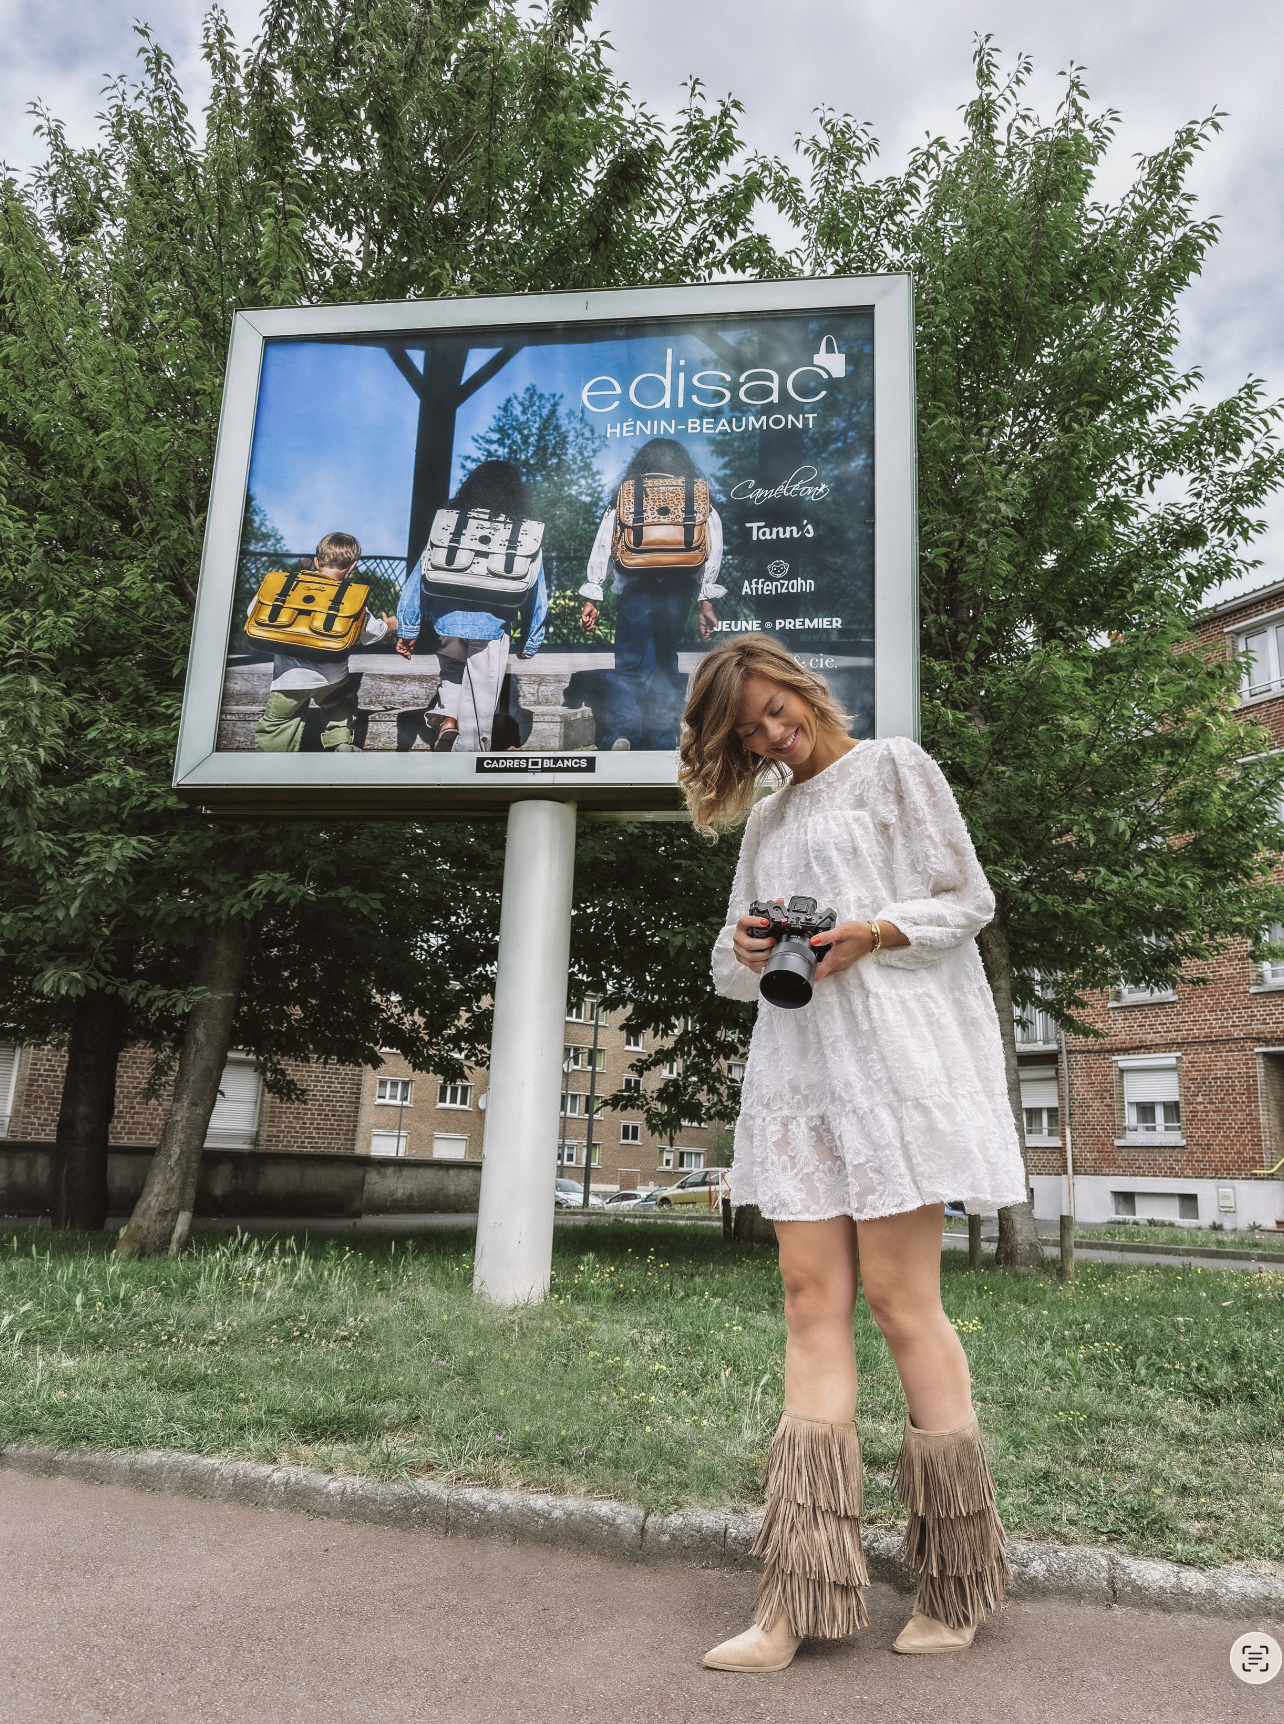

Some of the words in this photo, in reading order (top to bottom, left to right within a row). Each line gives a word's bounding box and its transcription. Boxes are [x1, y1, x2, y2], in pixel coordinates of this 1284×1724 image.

[582, 348, 829, 413] edisac
[606, 413, 818, 438] HÉNIN-BEAUMONT
[745, 520, 815, 541] Tann's
[741, 576, 815, 596] Affenzahn
[713, 620, 761, 631] JEUNE
[775, 618, 841, 630] PREMIER
[483, 760, 526, 768] CADRES
[543, 759, 587, 767] BLANCS
